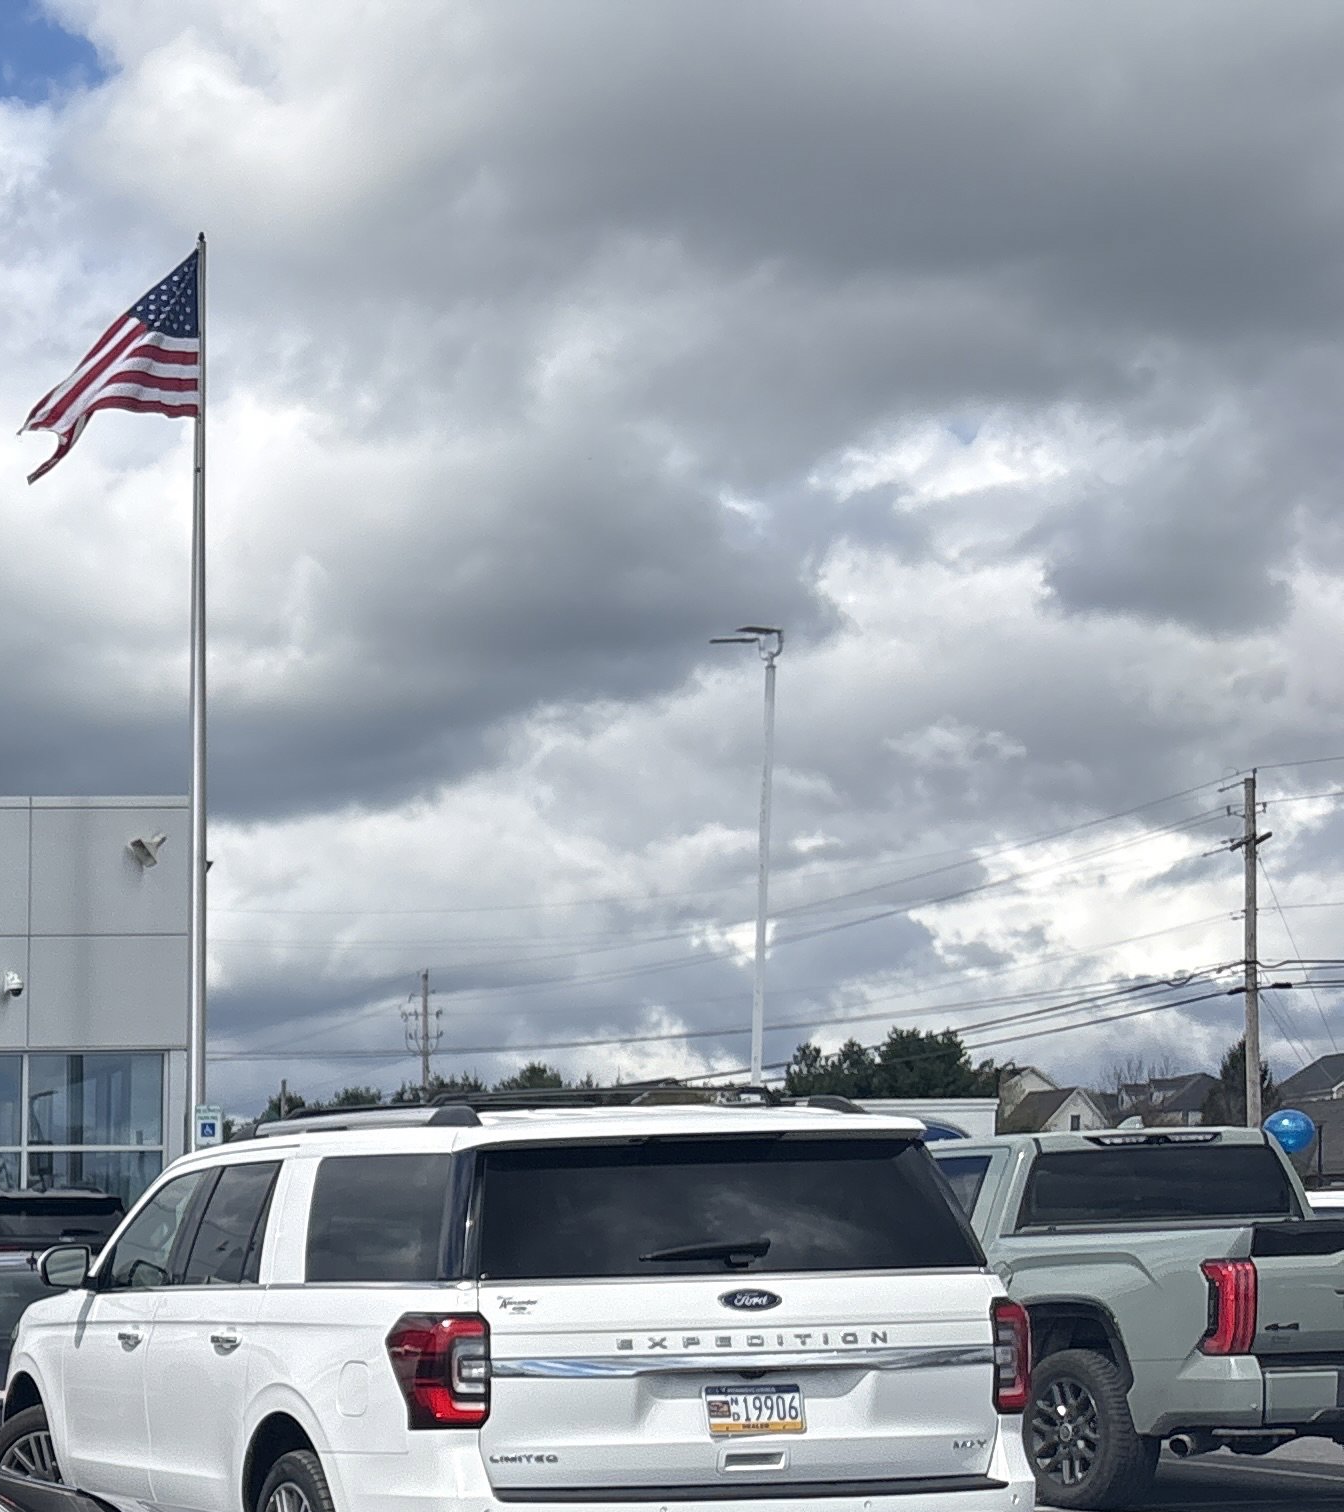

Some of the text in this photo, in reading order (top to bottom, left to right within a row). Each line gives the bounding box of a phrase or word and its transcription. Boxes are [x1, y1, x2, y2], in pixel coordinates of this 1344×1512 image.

[733, 1292, 769, 1306] Ford
[615, 1330, 888, 1351] EXPEDITION
[742, 1395, 799, 1422] 19906
